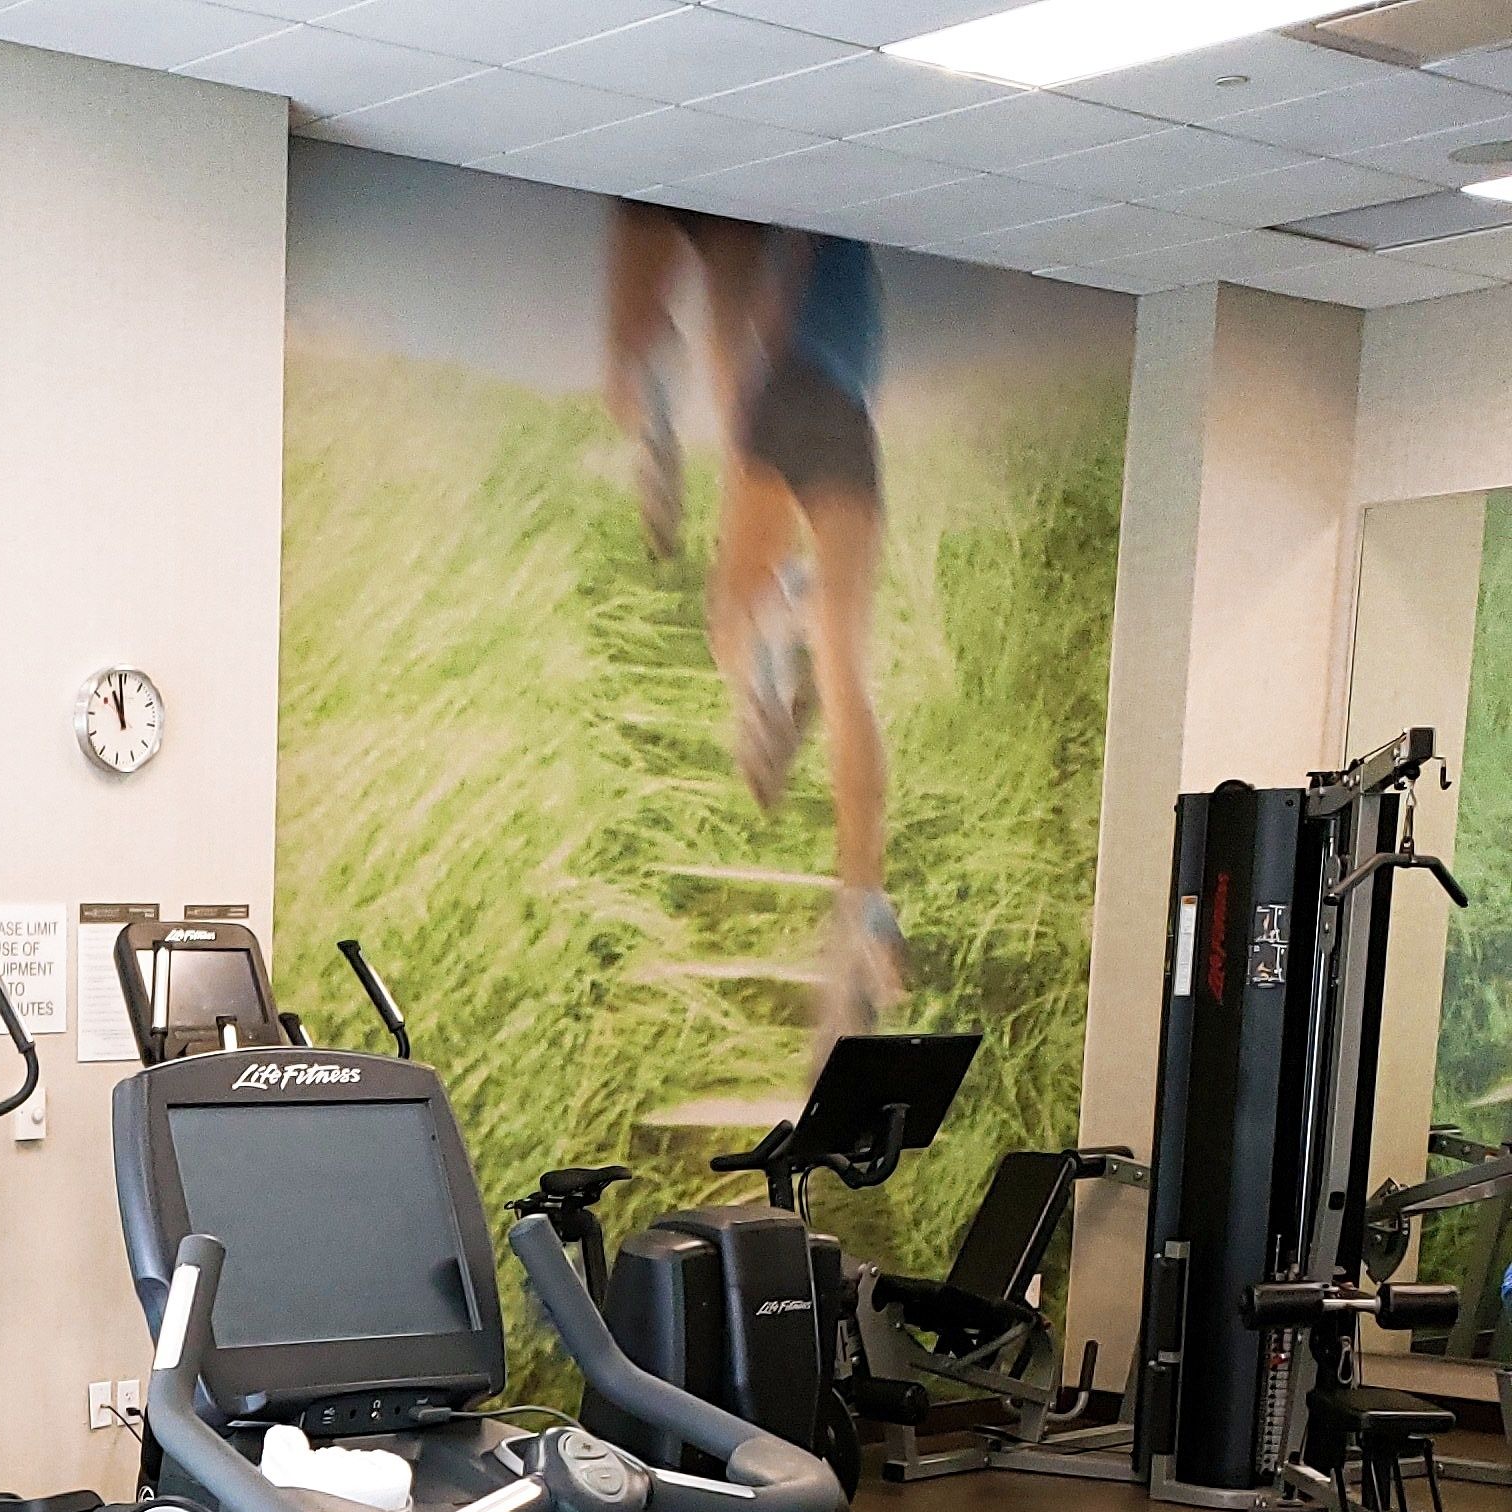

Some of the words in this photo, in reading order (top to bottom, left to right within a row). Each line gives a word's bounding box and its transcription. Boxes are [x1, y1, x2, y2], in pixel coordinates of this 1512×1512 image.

[26, 921, 58, 937] LIMIT
[22, 941, 40, 957] OF
[8, 981, 25, 997] TO
[231, 1063, 283, 1091] Life
[280, 1063, 361, 1091] Fitness
